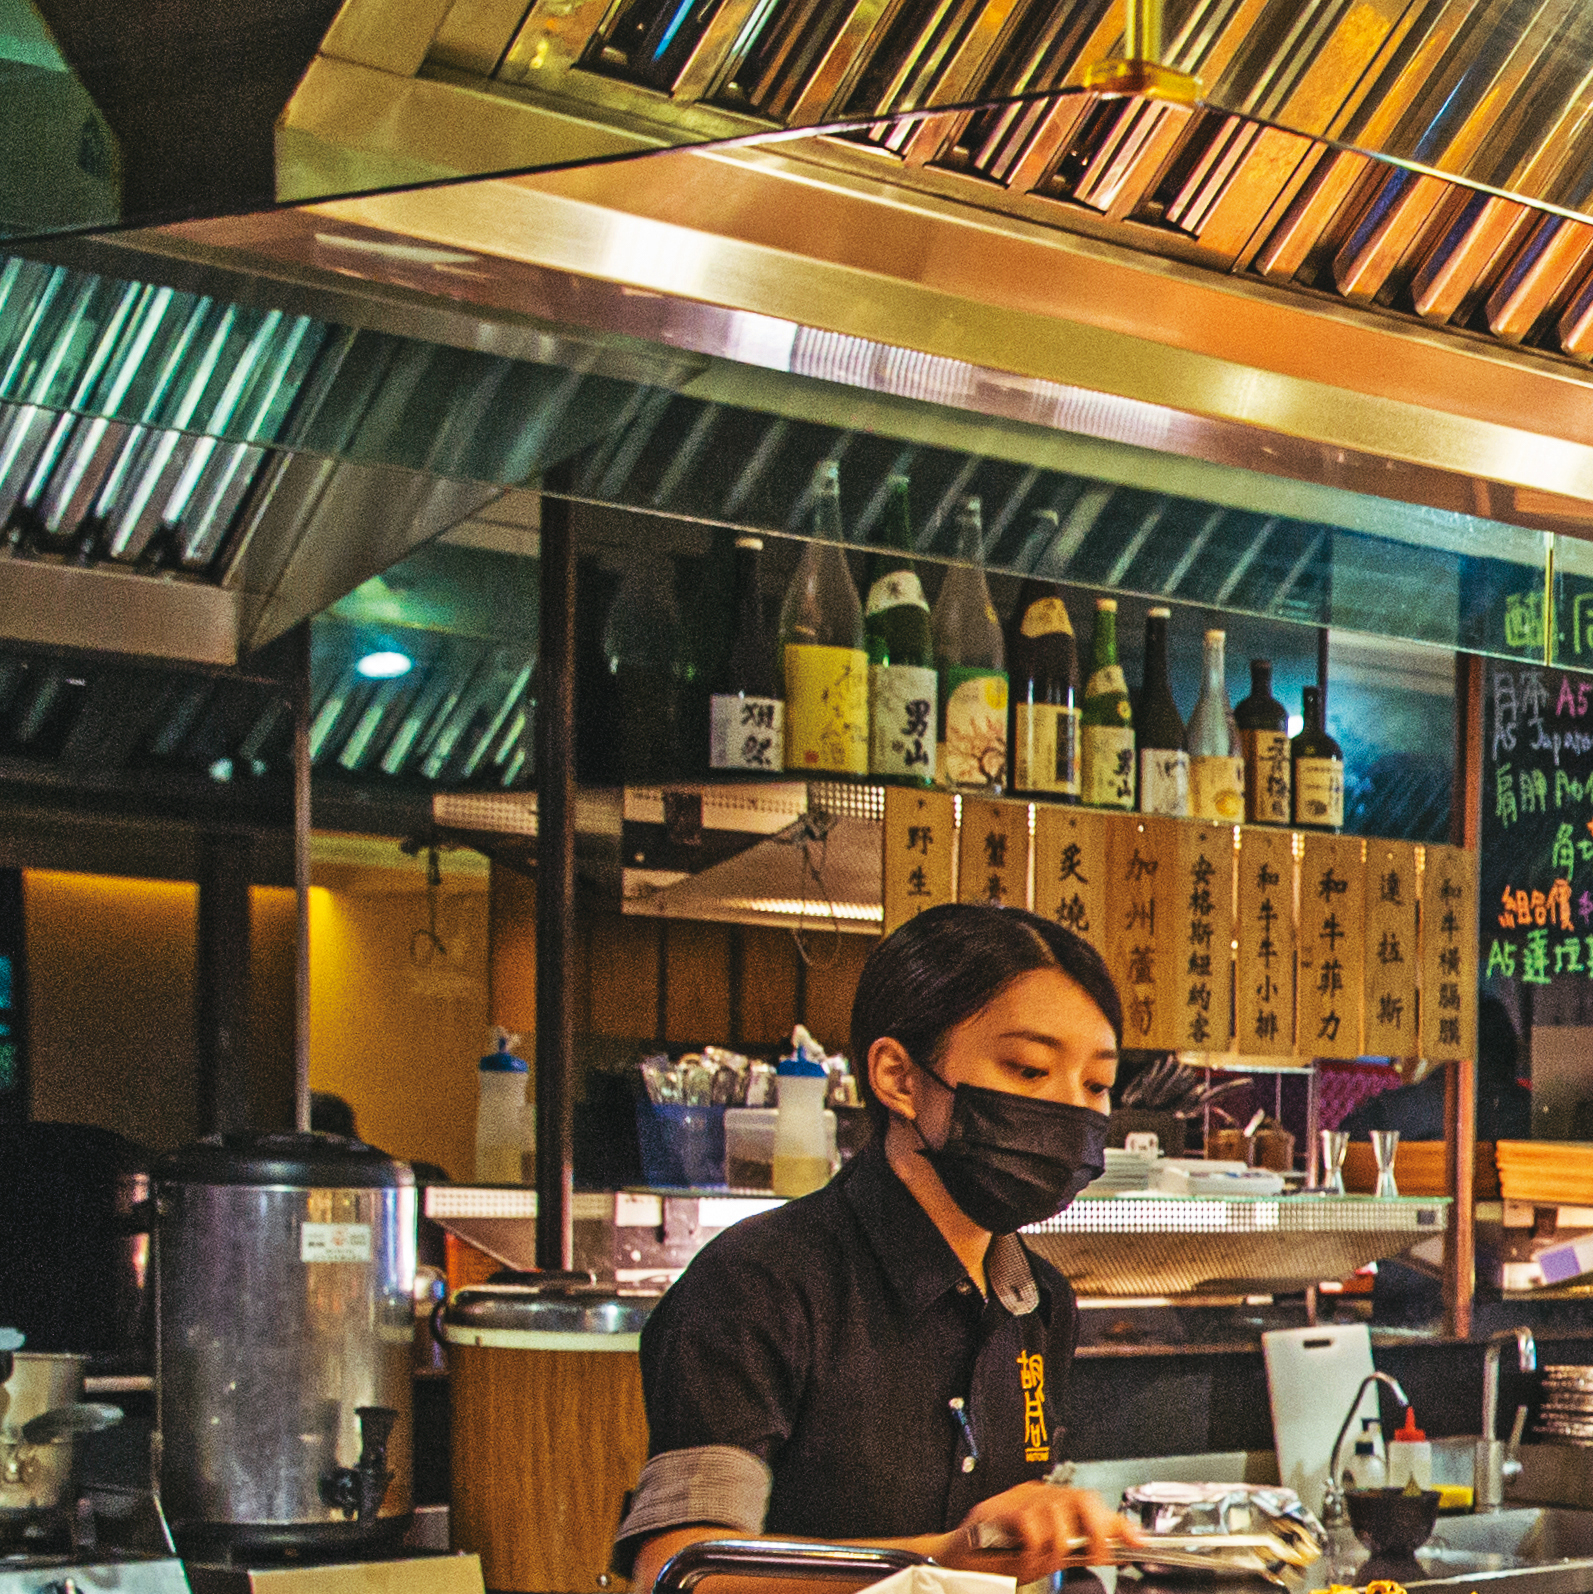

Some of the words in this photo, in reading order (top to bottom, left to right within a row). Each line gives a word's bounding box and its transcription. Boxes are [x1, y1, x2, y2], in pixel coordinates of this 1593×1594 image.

[902, 699, 931, 767] 男山
[906, 826, 934, 917] 野生
[1255, 863, 1281, 1043] 和牛牛小排
[1315, 867, 1349, 1042] 和牛菲力
